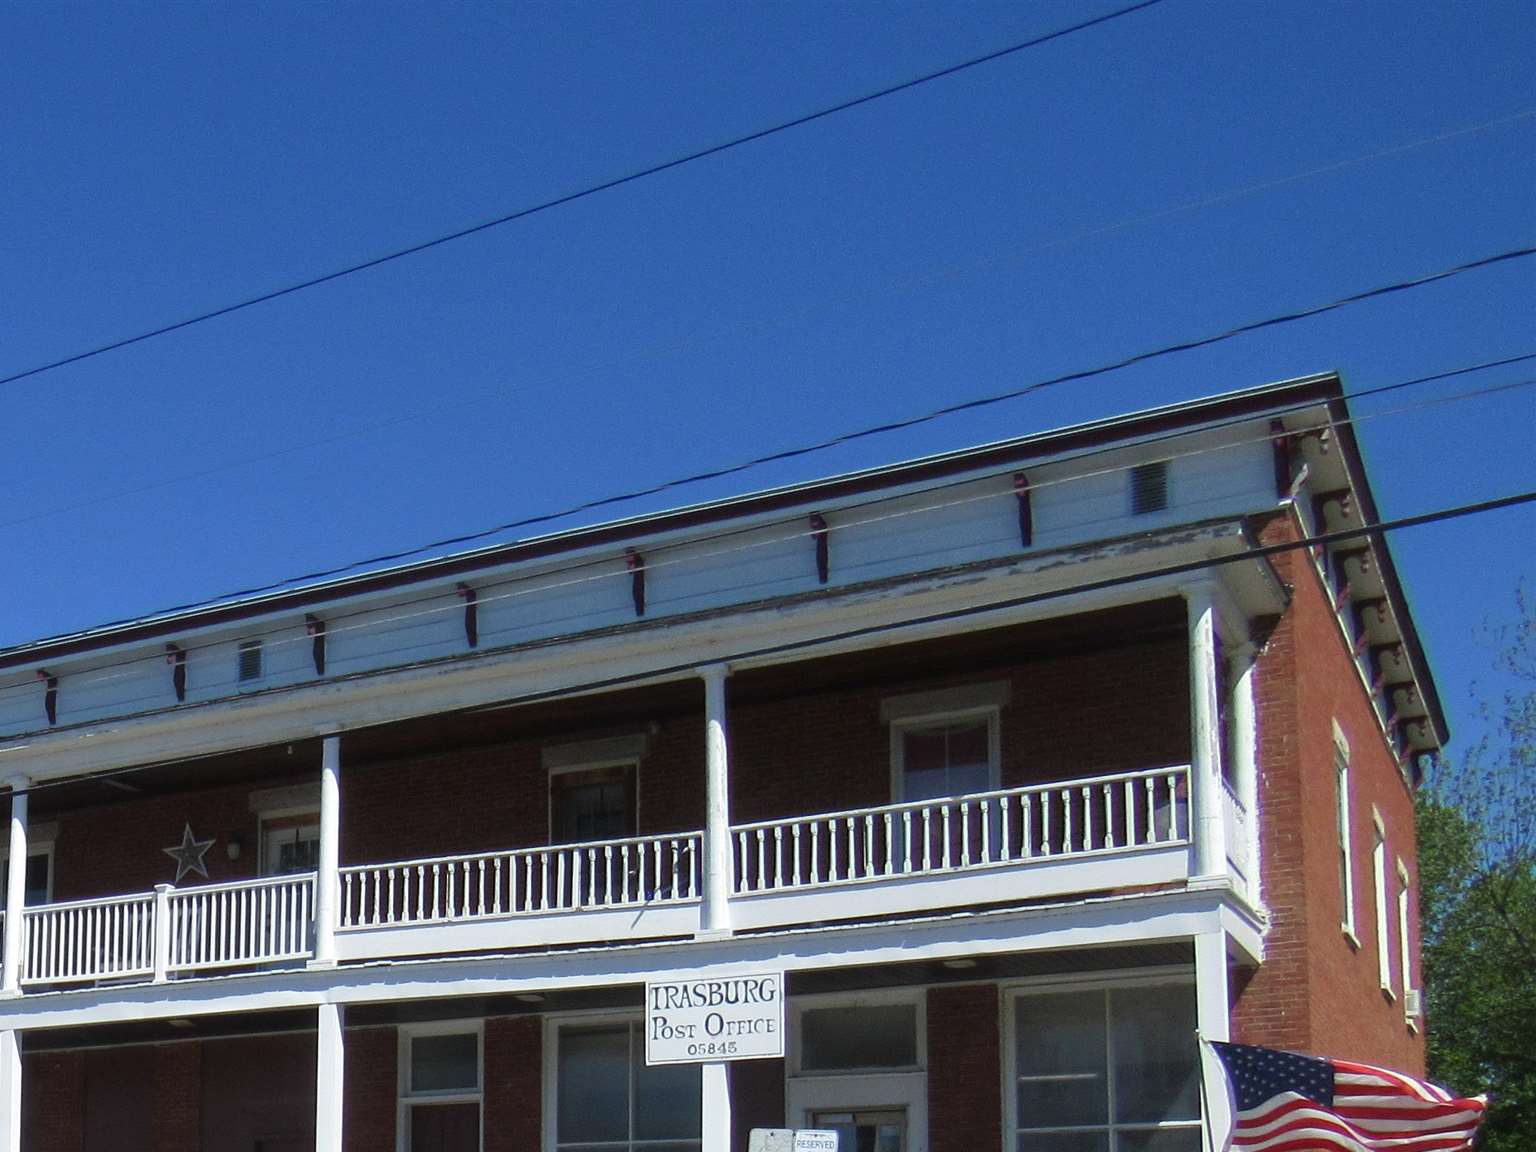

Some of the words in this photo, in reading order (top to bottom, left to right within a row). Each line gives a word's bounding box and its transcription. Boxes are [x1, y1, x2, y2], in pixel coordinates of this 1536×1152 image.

[651, 978, 777, 1011] IRASBURG
[687, 1041, 737, 1056] 05845
[796, 1140, 835, 1149] RESERVED
